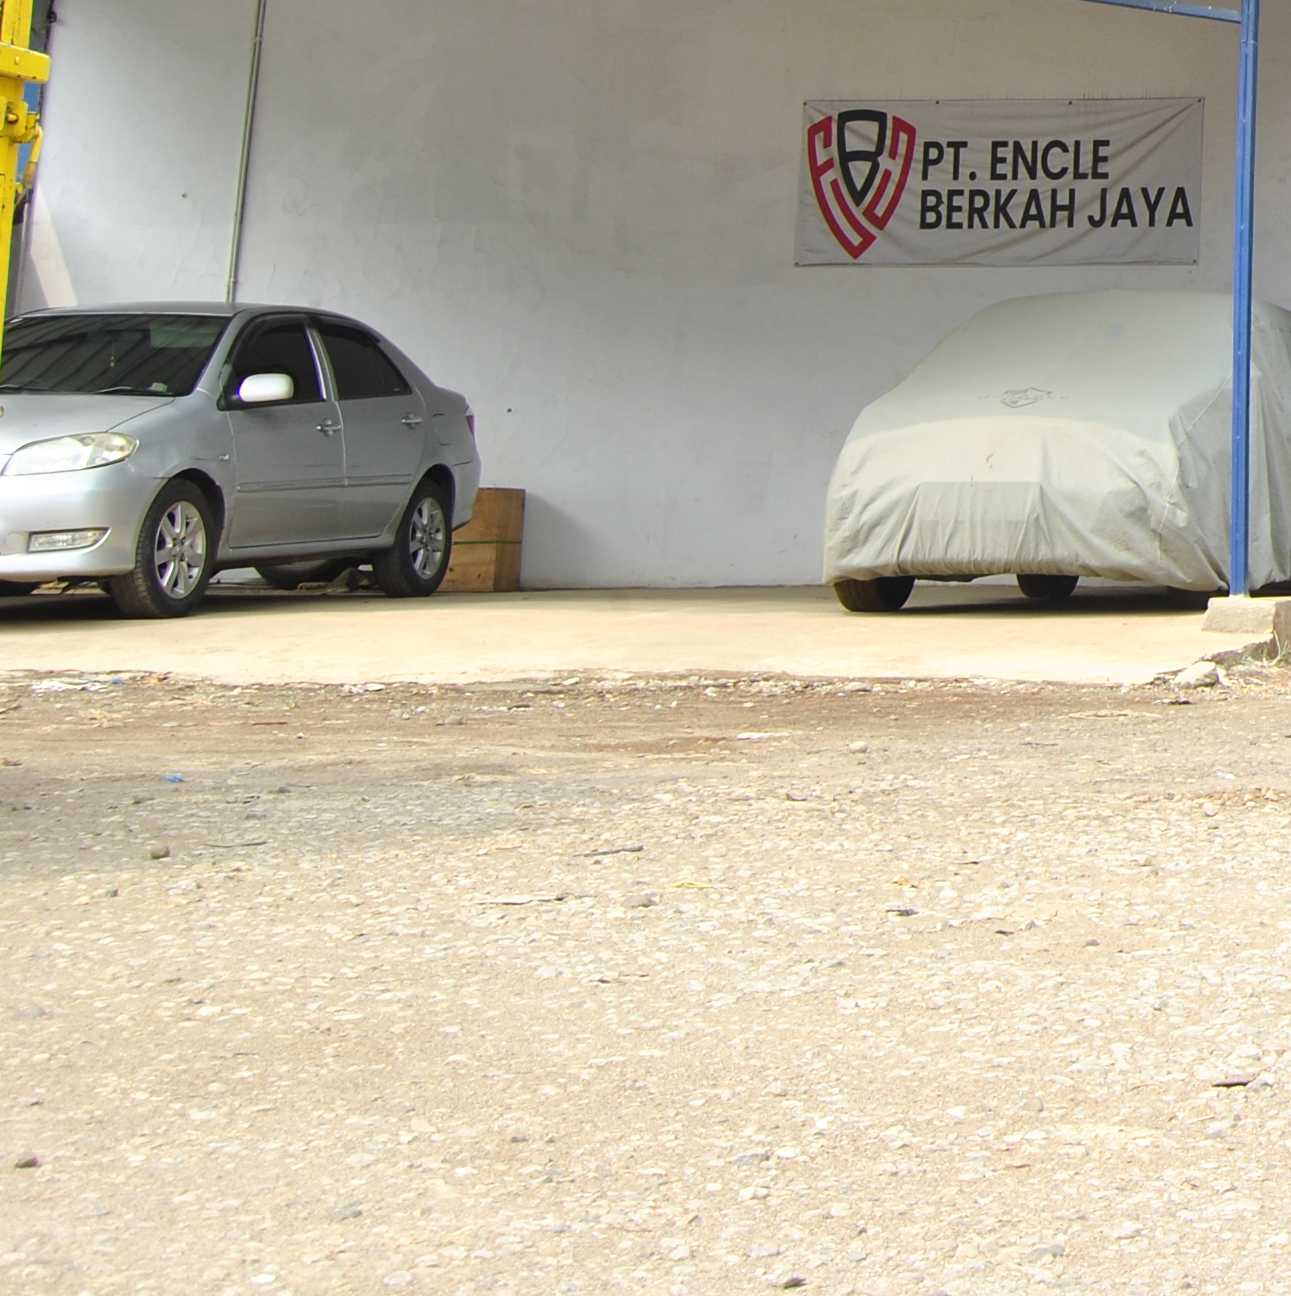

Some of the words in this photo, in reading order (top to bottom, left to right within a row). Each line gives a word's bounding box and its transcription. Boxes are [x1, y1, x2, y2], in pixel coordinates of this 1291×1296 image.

[921, 140, 978, 182] PT.
[989, 139, 1111, 181] ENCLE
[919, 187, 1076, 230] BERKAH
[1087, 186, 1194, 229] JAYA
